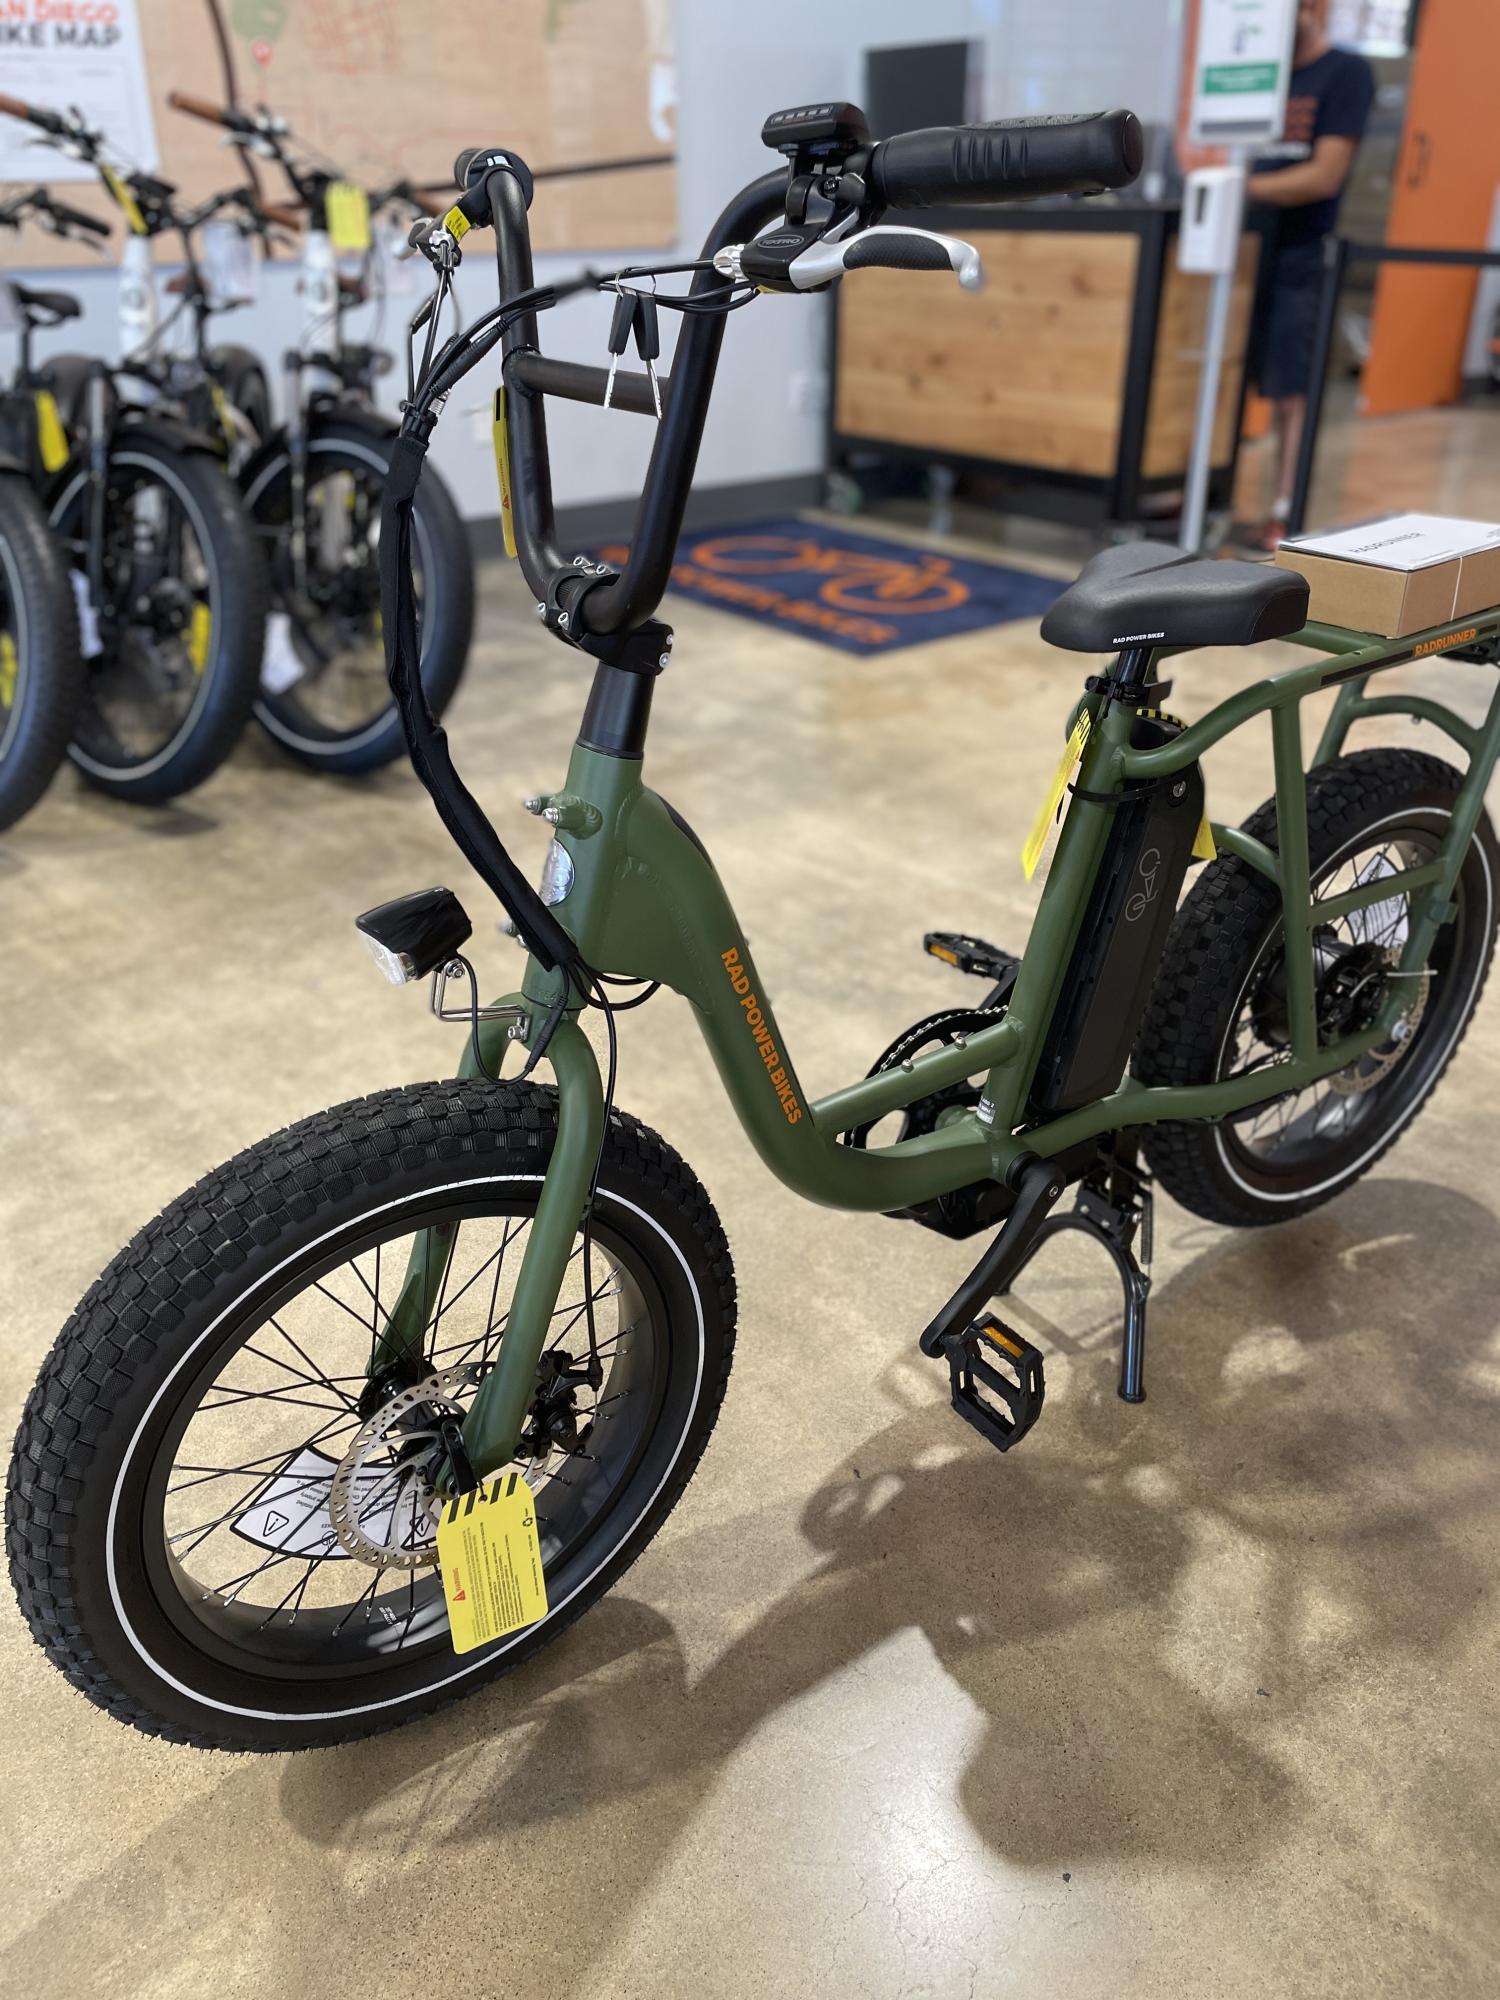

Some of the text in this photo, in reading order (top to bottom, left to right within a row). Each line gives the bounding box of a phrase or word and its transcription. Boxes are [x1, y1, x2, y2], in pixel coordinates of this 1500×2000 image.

[34, 0, 119, 22] DIEGO
[0, 23, 122, 48] IKE MAP
[1112, 631, 1165, 645] RAD POWER BIKES
[1414, 627, 1478, 657] RADRUNNER
[720, 947, 802, 1125] RAD POWER BIKES
